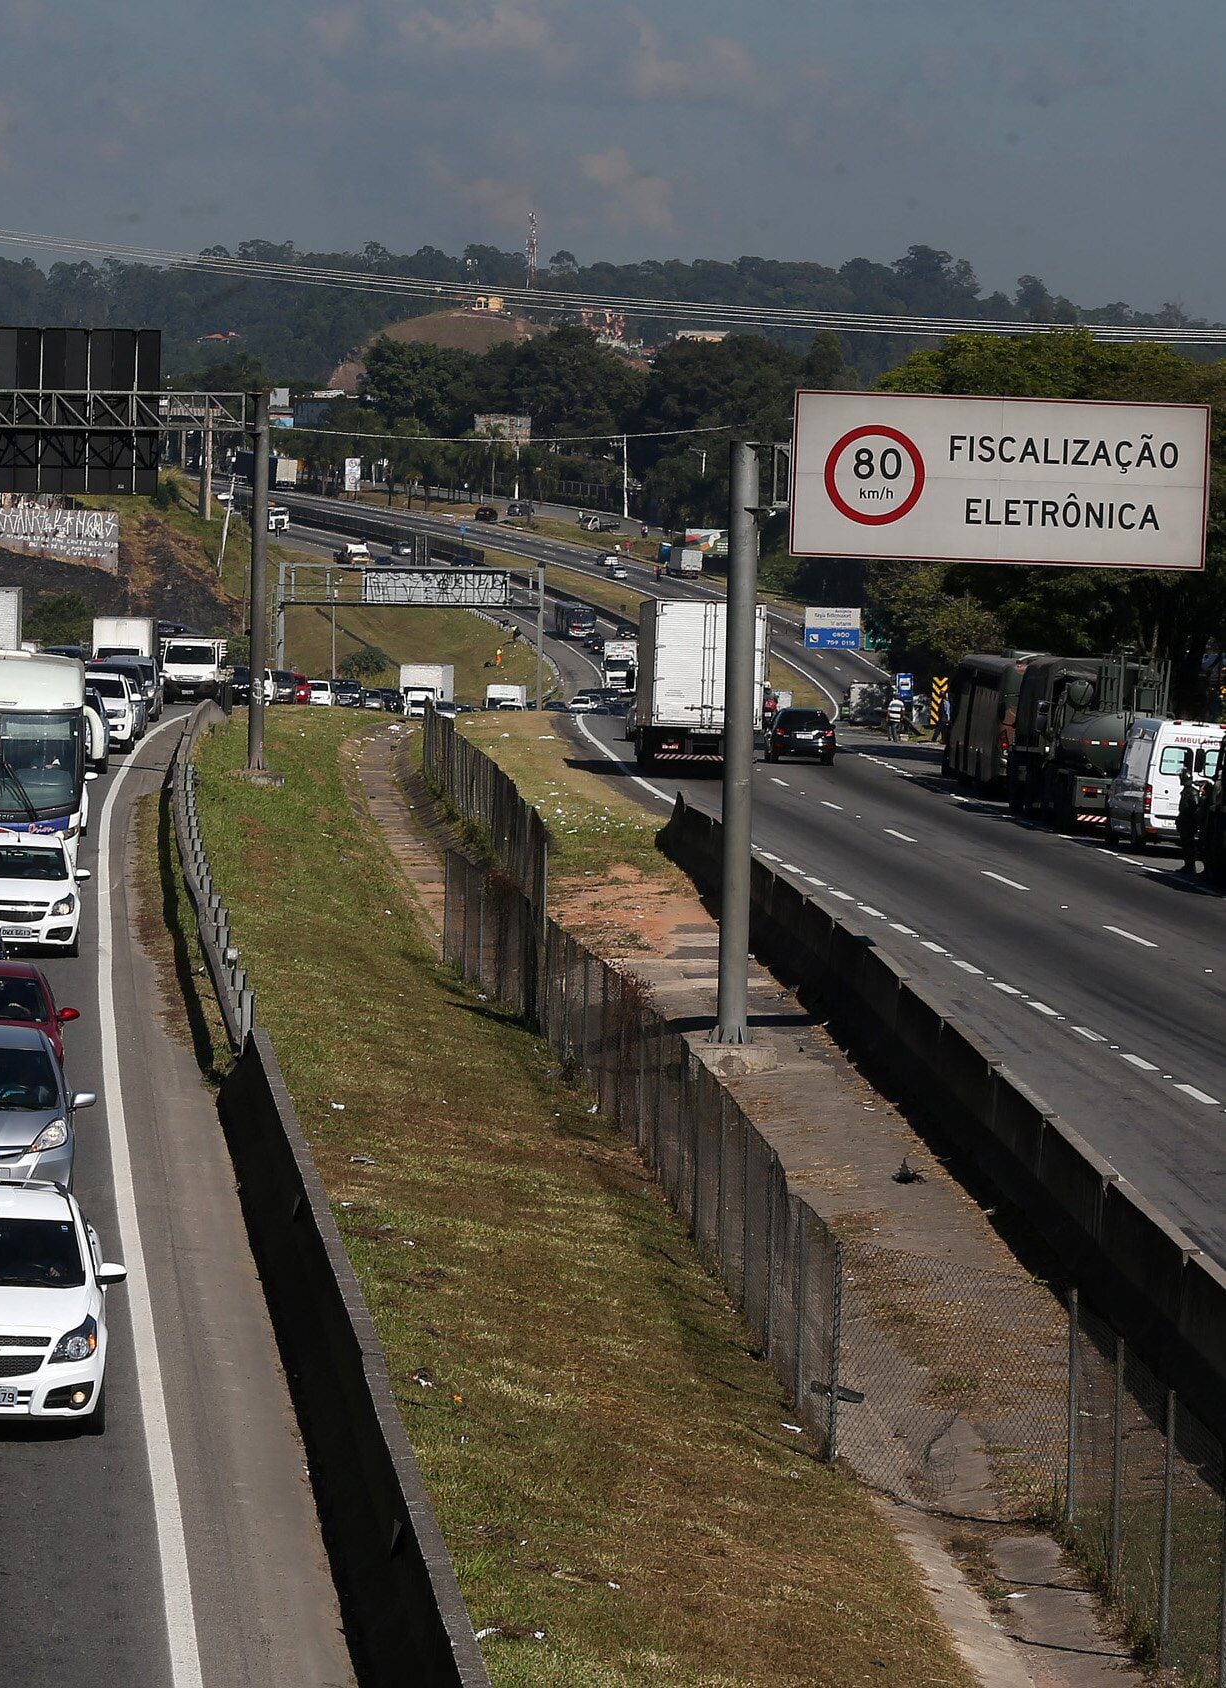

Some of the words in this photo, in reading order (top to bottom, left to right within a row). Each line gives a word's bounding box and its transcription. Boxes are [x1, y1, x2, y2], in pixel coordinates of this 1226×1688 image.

[853, 448, 903, 481] 80
[948, 434, 1179, 474] FISCALIZAÇÃO
[859, 486, 894, 501] km/h
[965, 492, 1160, 531] ELETRÔNICA
